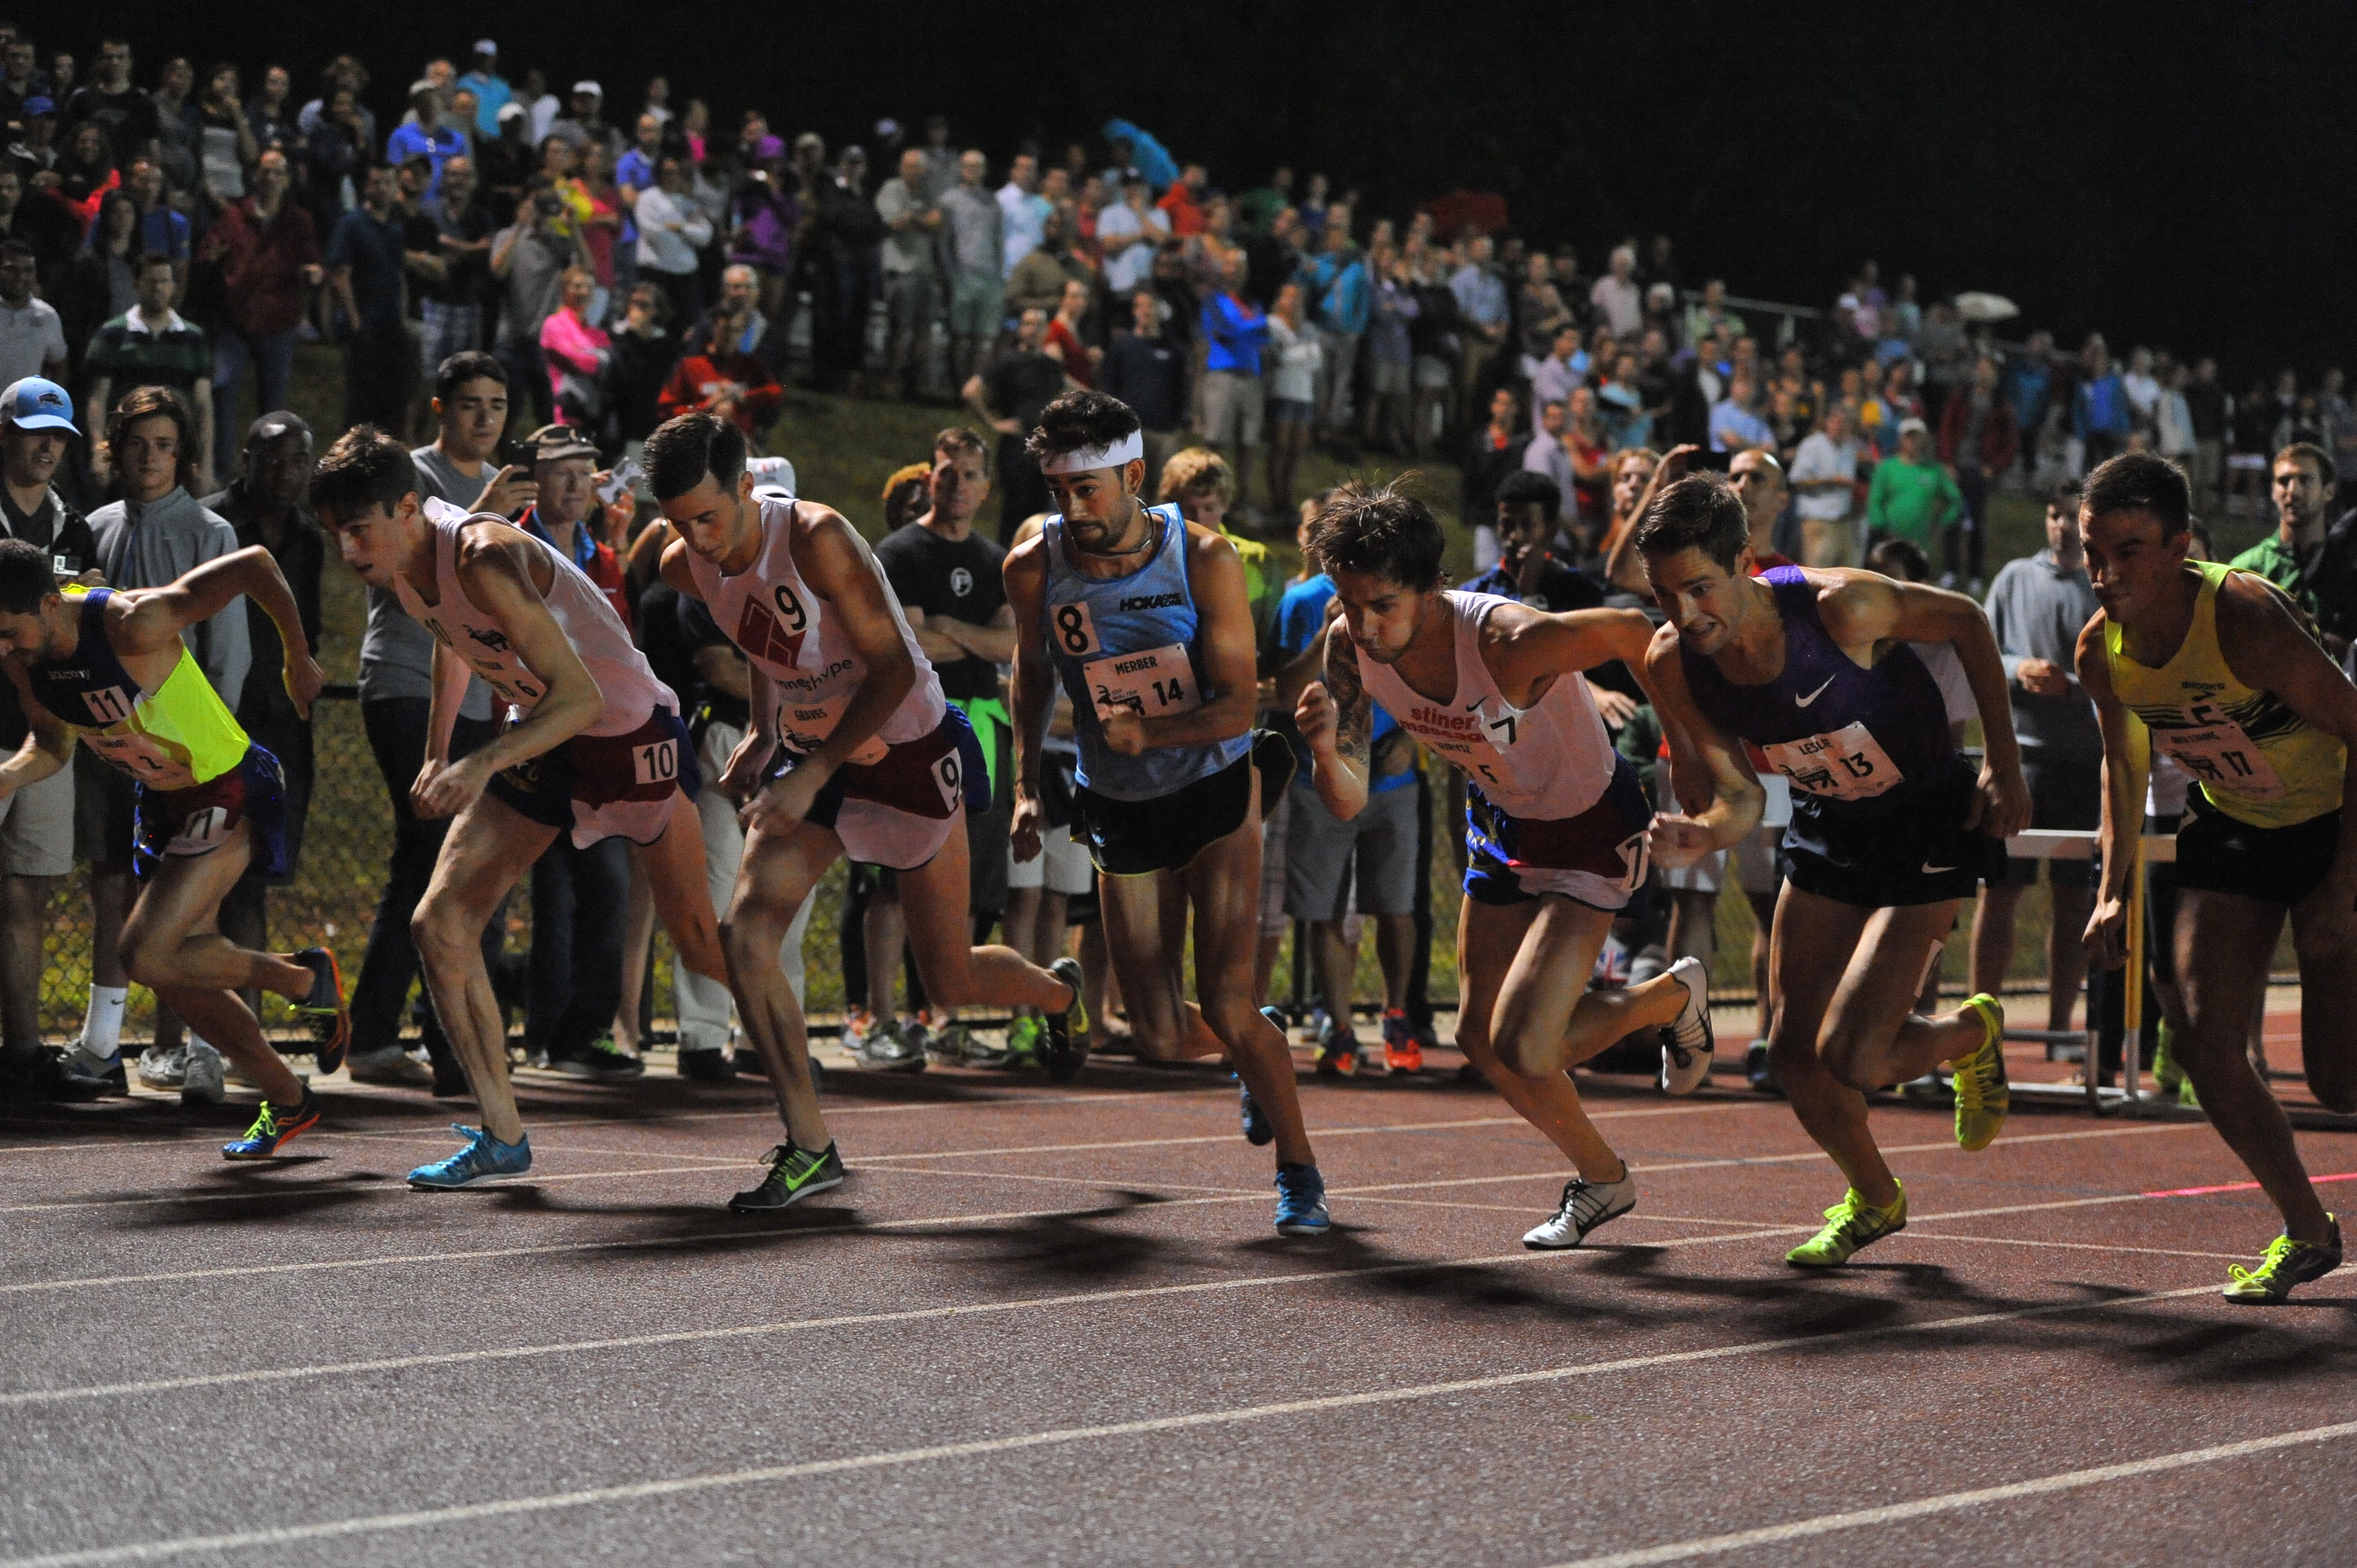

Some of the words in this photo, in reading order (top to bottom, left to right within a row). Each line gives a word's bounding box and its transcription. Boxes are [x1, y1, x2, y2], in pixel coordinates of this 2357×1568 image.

[775, 585, 806, 631] 9
[1120, 595, 1163, 611] HOKA
[424, 617, 453, 647] 10
[1057, 606, 1089, 653] 8
[1115, 656, 1158, 675] MERBER
[1112, 690, 1138, 701] WALTER
[1152, 677, 1185, 706] 14
[2182, 681, 2226, 690] BROOKS
[90, 689, 126, 720] 11
[794, 708, 827, 721] GRAVES
[1411, 706, 1476, 730] stiner
[1490, 715, 1517, 746] 7
[1798, 738, 1834, 755] LESLIE
[643, 742, 673, 780] 10
[1839, 751, 1874, 778] 13
[2221, 751, 2254, 777] 17
[940, 756, 960, 804] 9
[1625, 836, 1643, 889] 7
